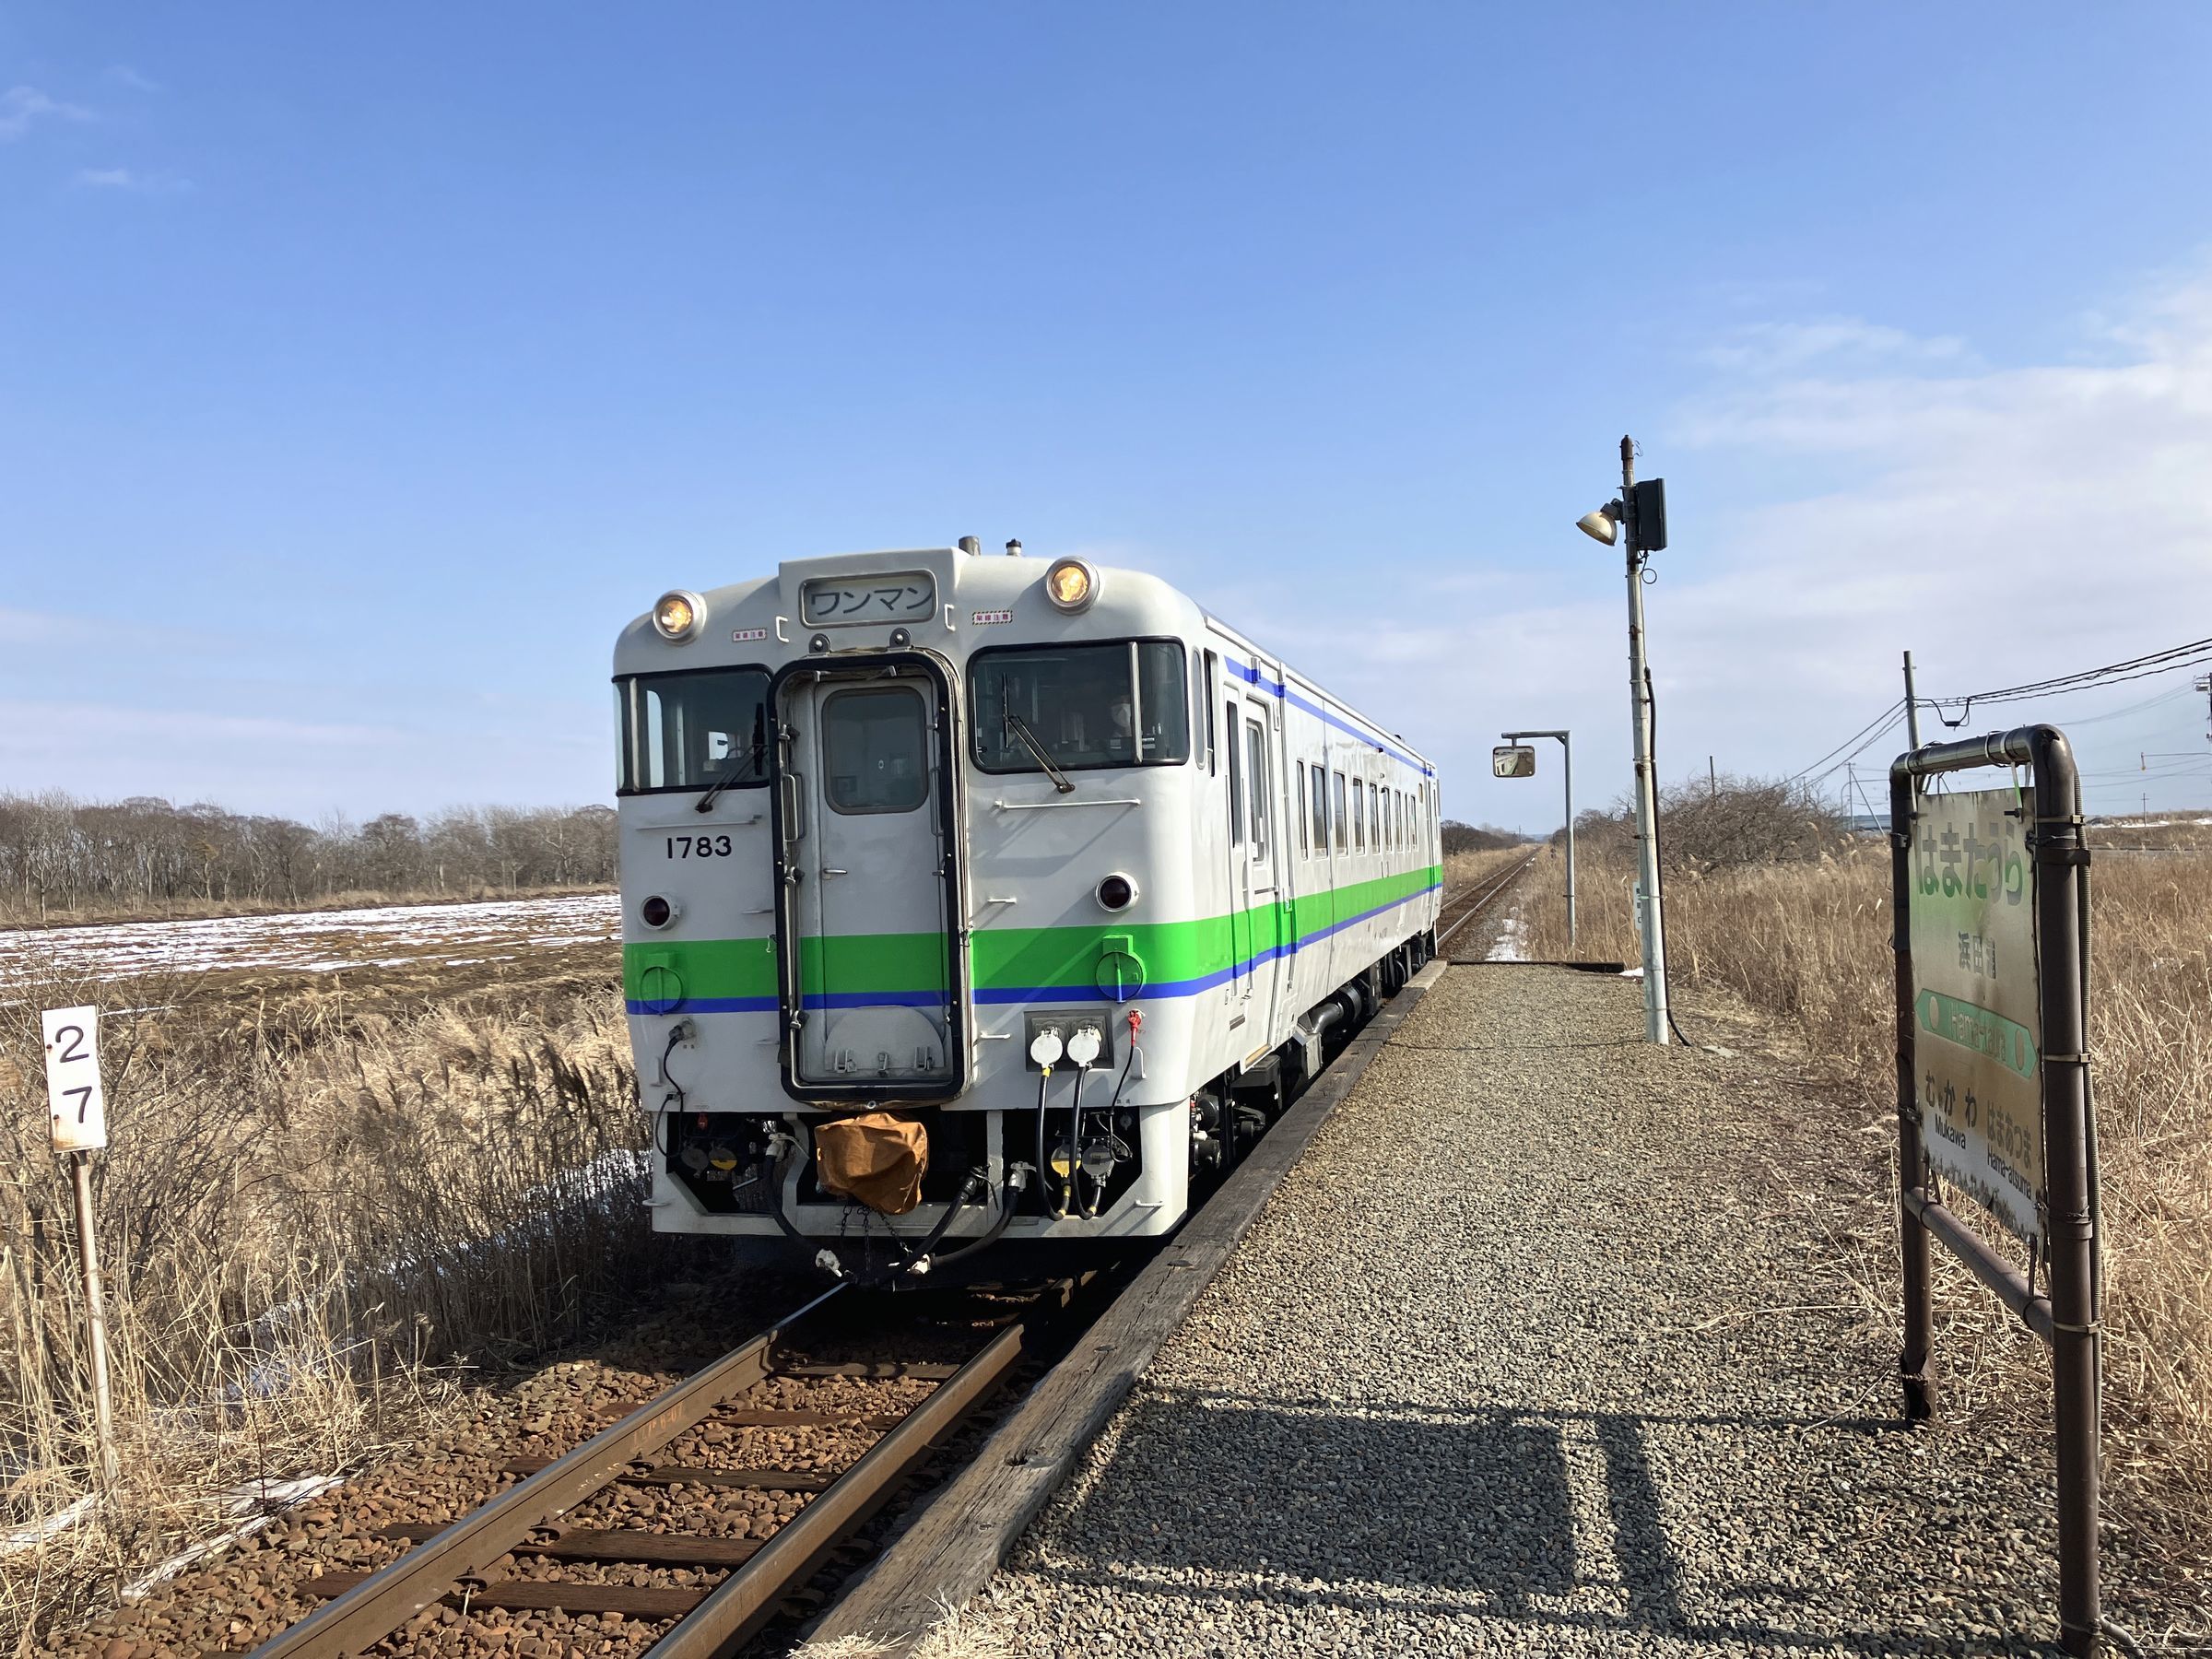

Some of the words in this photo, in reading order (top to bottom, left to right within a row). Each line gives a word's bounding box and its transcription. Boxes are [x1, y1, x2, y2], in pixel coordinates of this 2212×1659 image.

[810, 586, 933, 616] ワンマン
[666, 835, 732, 859] 1783
[1913, 820, 2023, 906] はまたうら
[1935, 1113, 1967, 1150] Mukawa
[1987, 1143, 2032, 1200] Hama-atsuma
